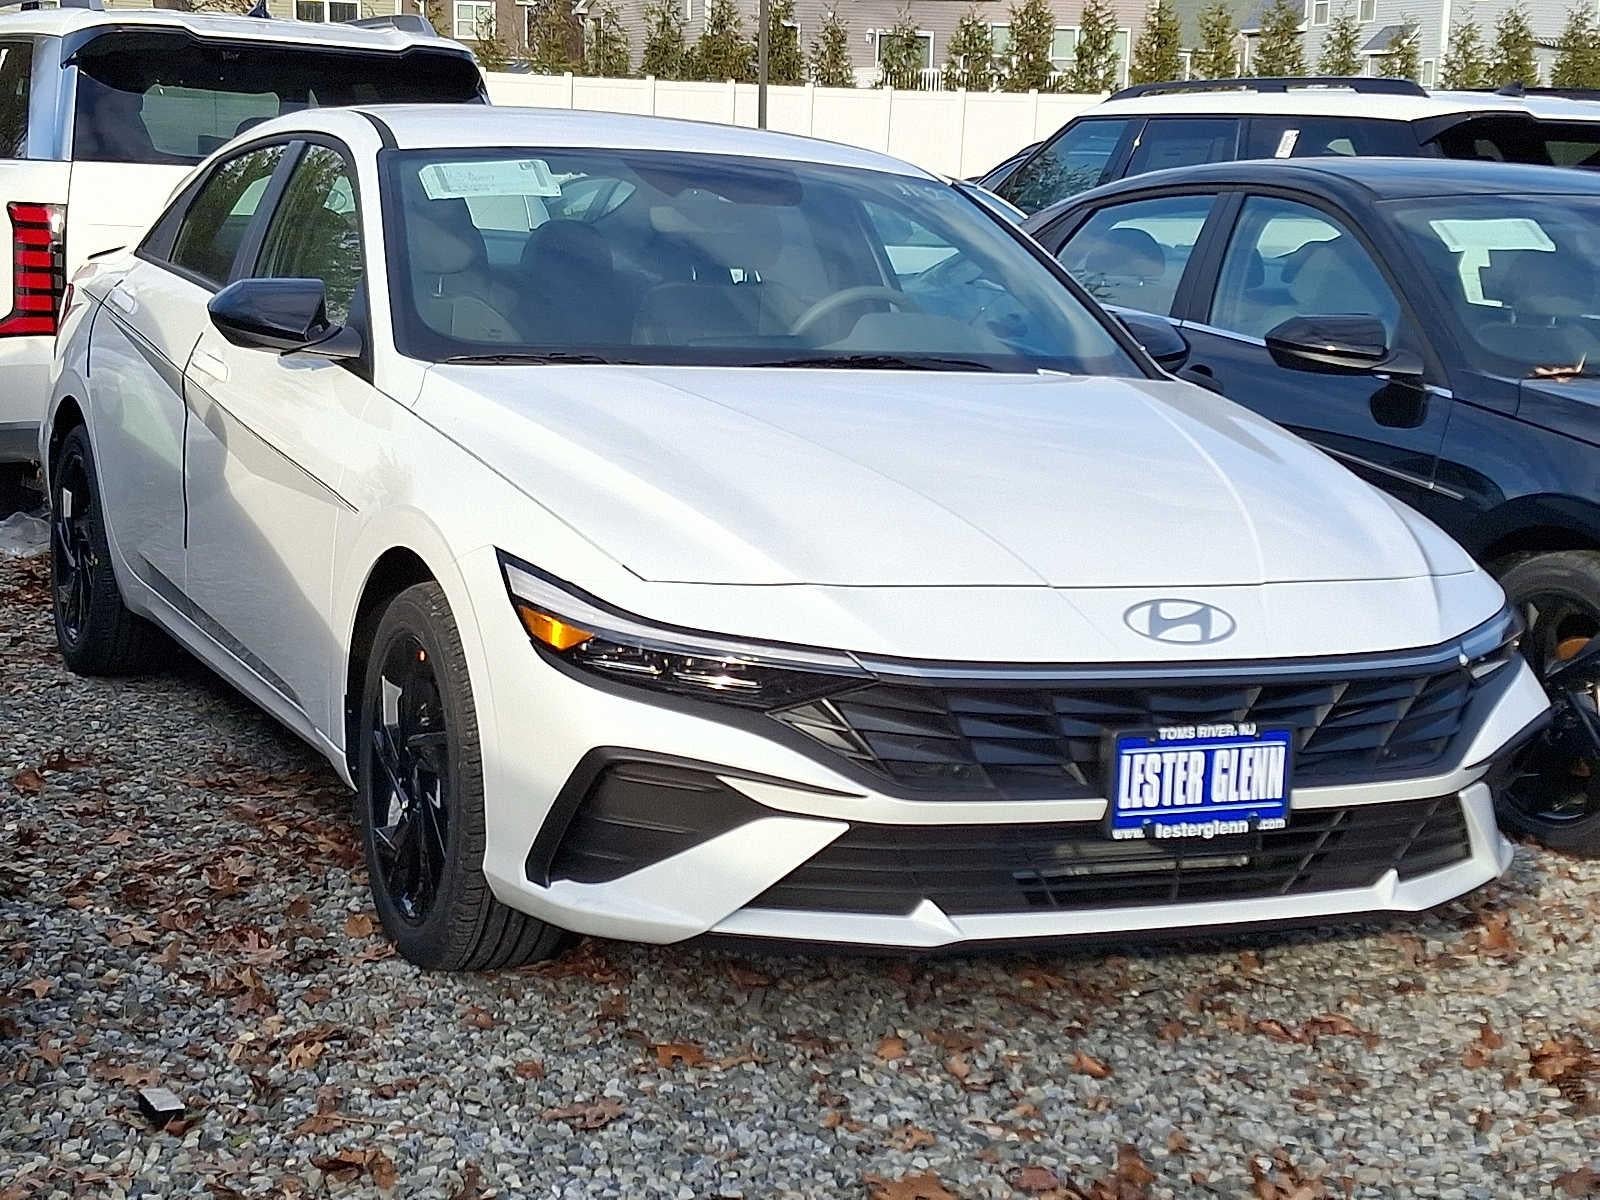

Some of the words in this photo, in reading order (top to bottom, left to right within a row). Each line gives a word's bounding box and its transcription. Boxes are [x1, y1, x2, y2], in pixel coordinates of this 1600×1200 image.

[1158, 726, 1195, 740] TOMS
[1239, 722, 1257, 736] NJ
[1118, 751, 1205, 809] LESTER
[1211, 746, 1286, 803] GLENN
[1112, 828, 1145, 840] www.
[1155, 820, 1249, 839] lesterglenn
